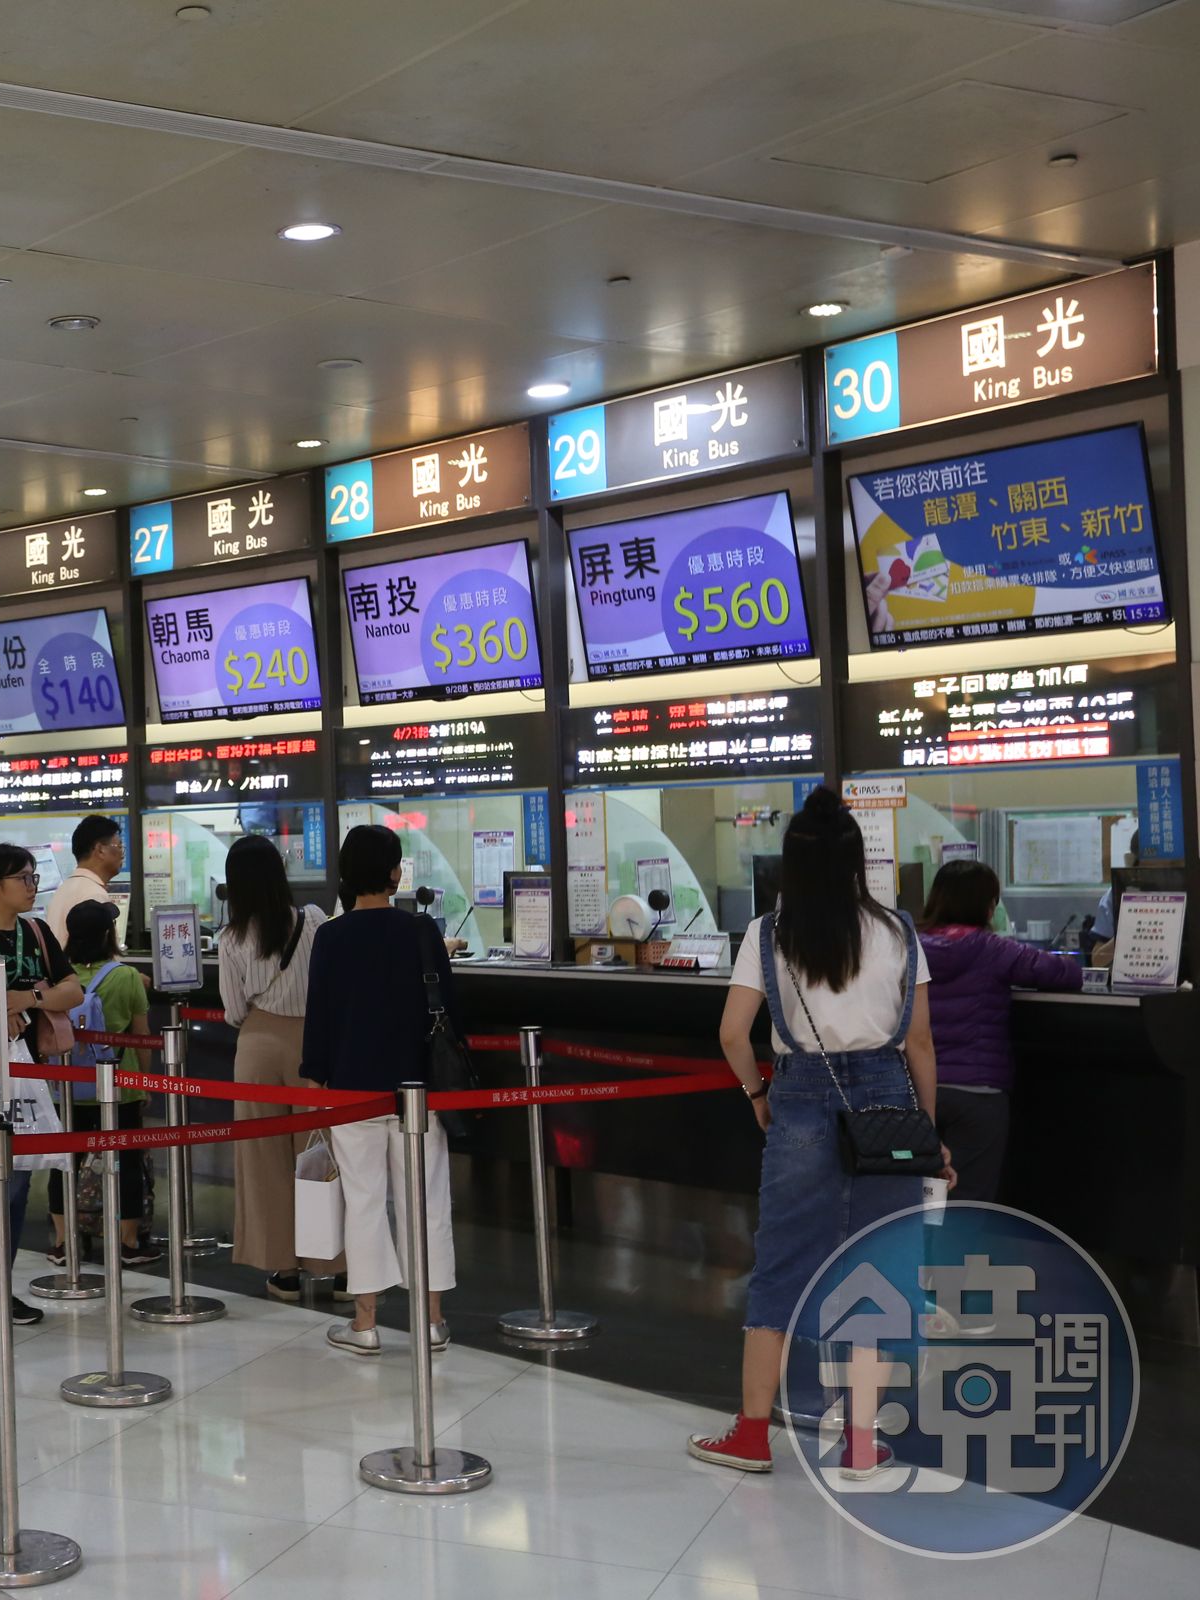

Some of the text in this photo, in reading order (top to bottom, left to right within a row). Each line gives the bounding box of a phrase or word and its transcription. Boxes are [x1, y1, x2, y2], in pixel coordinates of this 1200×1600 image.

[961, 297, 1086, 376] 國光
[833, 360, 892, 420] 30
[973, 366, 1073, 402] King Bus
[654, 382, 748, 446] 國光
[554, 429, 600, 480] 29
[663, 440, 739, 469] King Bus
[412, 443, 488, 498] 國光
[873, 462, 987, 501] 若您欲前往
[207, 490, 274, 537] 國光
[330, 481, 370, 525] 28
[420, 494, 481, 518] King Bus
[923, 477, 1069, 527] 龍潭、關西
[991, 503, 1144, 551] 竹東、新竹
[25, 526, 85, 568] 國光
[134, 524, 169, 563] 27
[214, 535, 267, 556] King Bus
[578, 536, 660, 588] 屏東
[688, 546, 765, 576] 優惠時段
[963, 564, 987, 578] 使用
[1058, 553, 1072, 565] 或
[31, 566, 79, 585] King Bus
[348, 576, 420, 622] 南投
[443, 586, 508, 613] 優惠時段
[590, 584, 656, 607] Pingtung
[673, 577, 790, 641] $560
[1130, 606, 1161, 619] 15:23
[151, 608, 213, 648] 朝馬
[235, 620, 291, 641] 優惠時段
[365, 622, 410, 639] Nantou
[161, 649, 210, 665] Chaoma
[431, 616, 528, 674] $360
[784, 645, 807, 655] 15:23
[38, 651, 105, 675] 全時段
[224, 646, 309, 696] $240
[523, 677, 542, 687] 15:23
[41, 674, 114, 721] $140
[860, 785, 880, 795] iPASS
[162, 922, 191, 940] 排隊
[160, 942, 195, 960] 起點
[114, 1073, 201, 1094] aipei Bus Station
[492, 1086, 619, 1102] 國光客運 KUO-KUANG TRANSPORT
[87, 1127, 232, 1148] 國光客運 KUO-KUANG TRANSPORT
